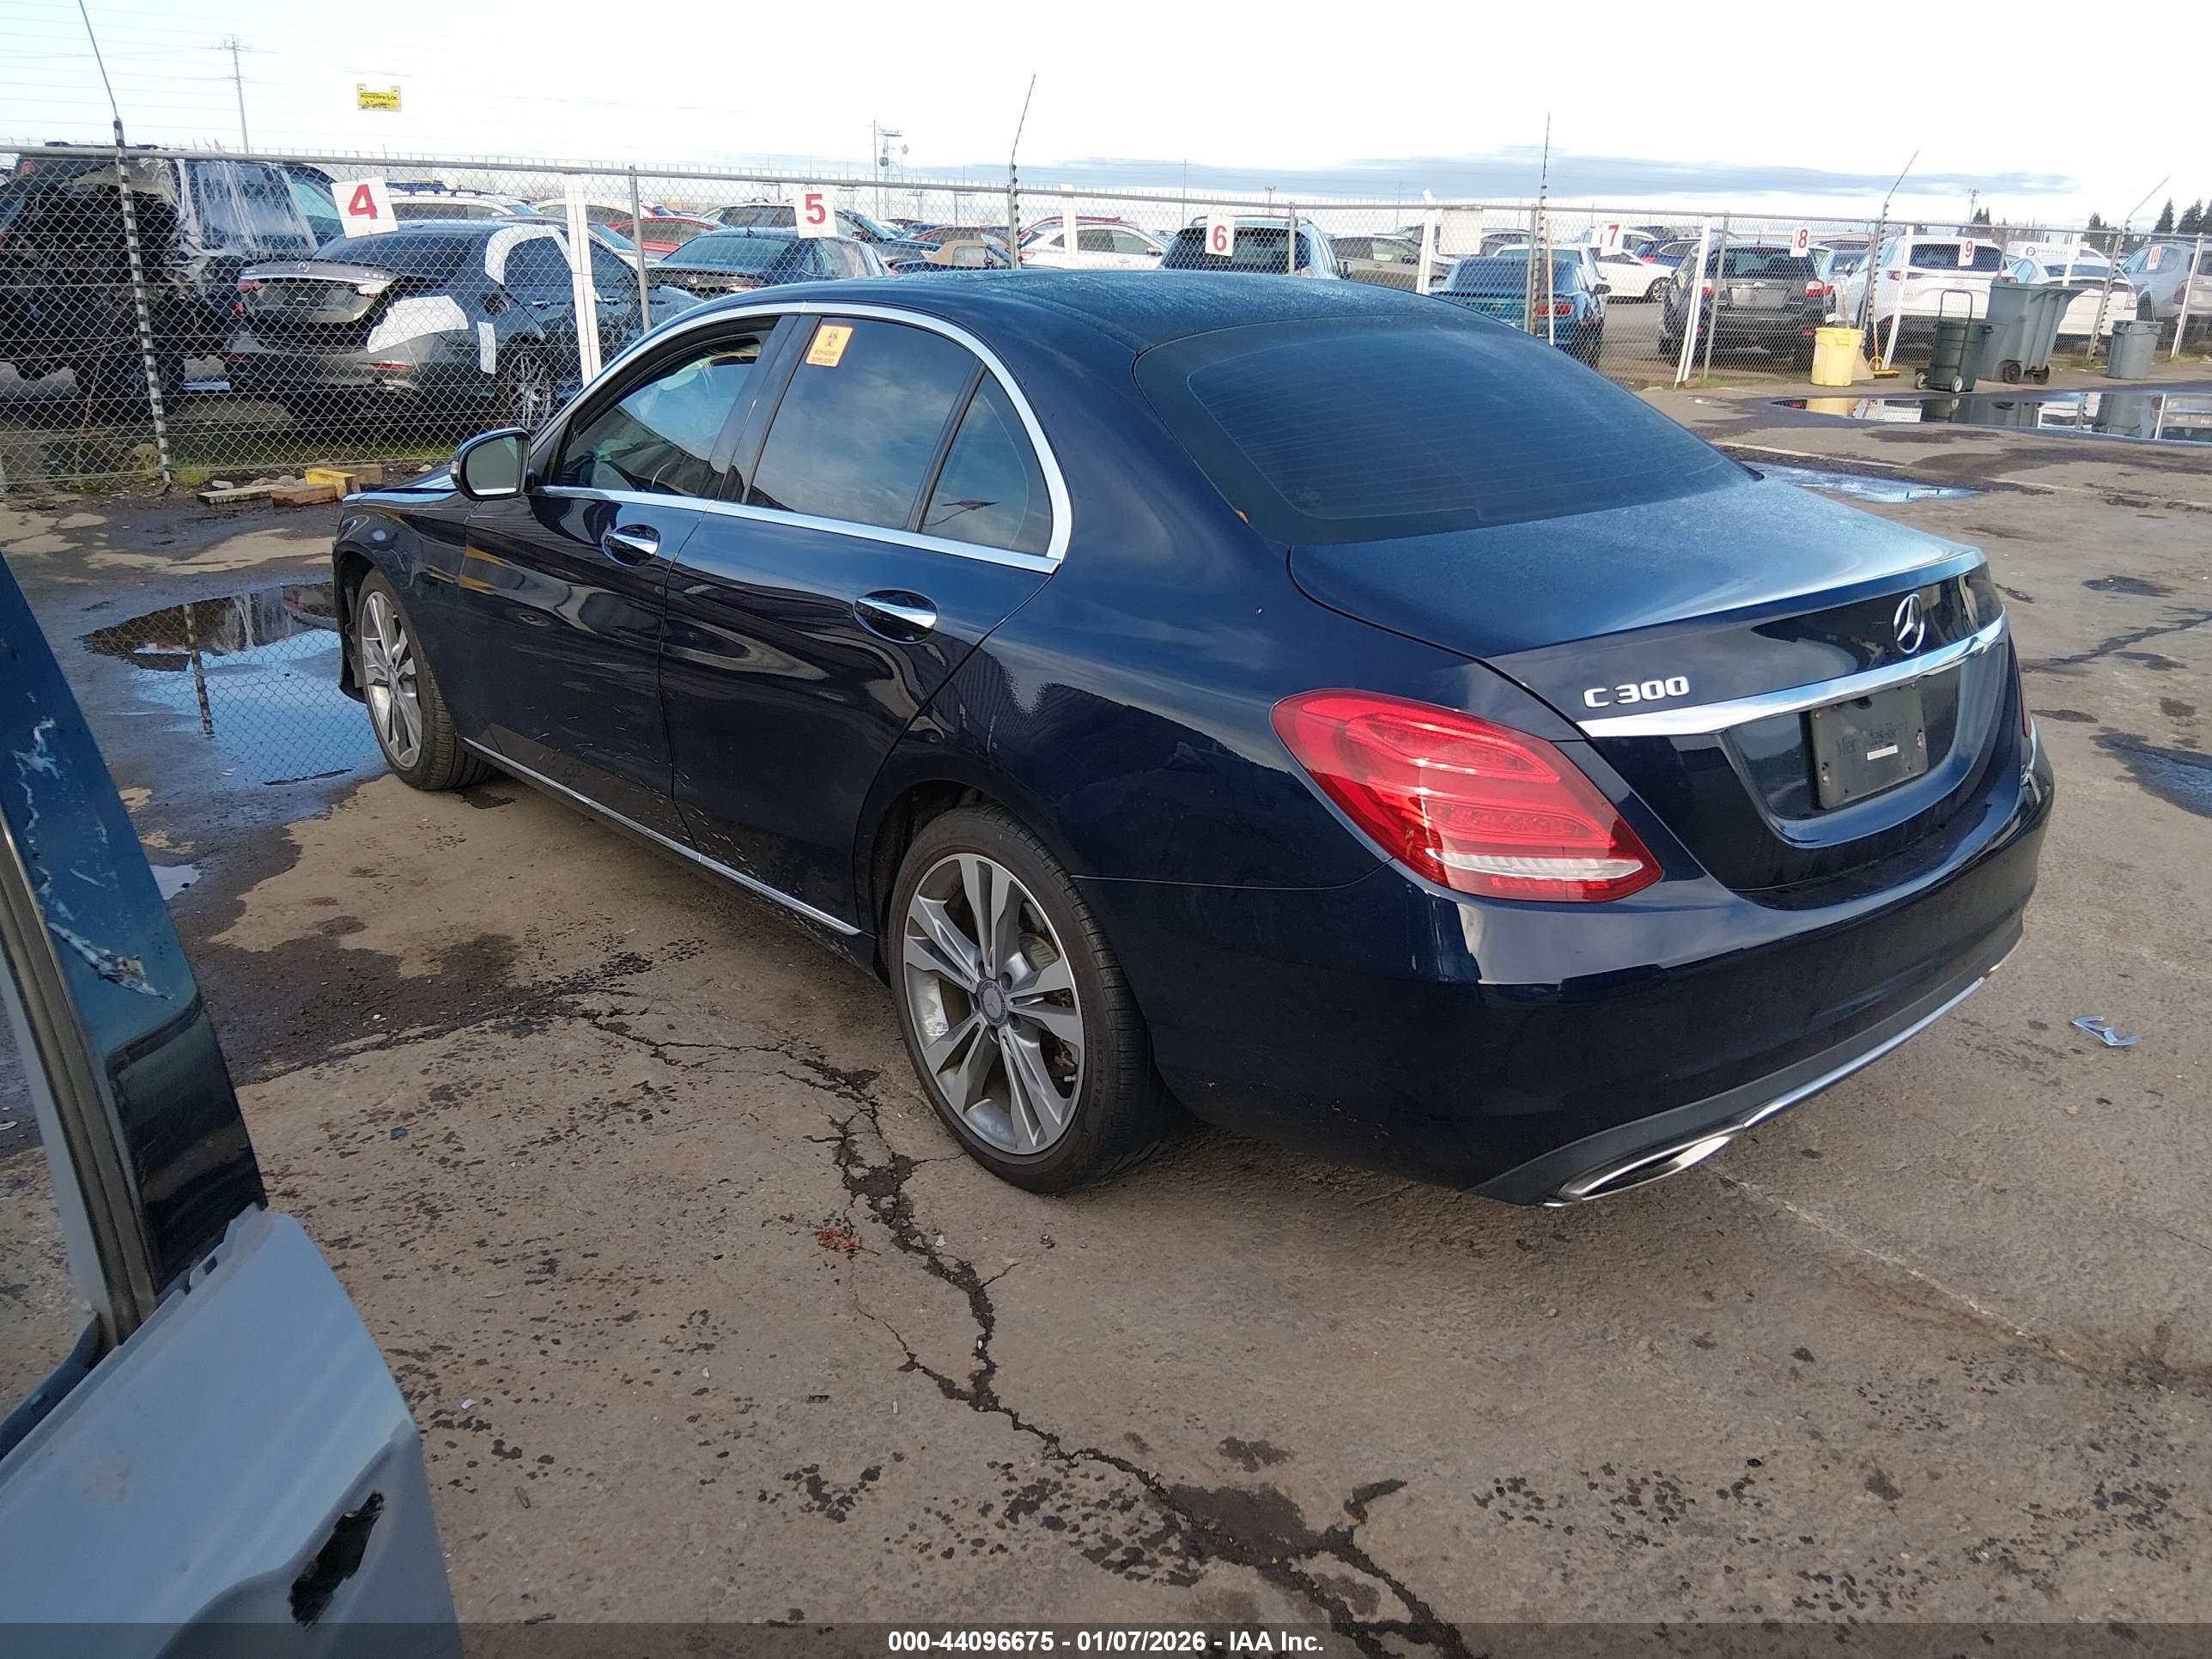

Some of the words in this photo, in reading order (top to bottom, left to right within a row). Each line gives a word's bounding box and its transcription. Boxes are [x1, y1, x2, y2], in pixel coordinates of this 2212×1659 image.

[349, 184, 378, 220] 4
[805, 193, 826, 225] 5
[1212, 225, 1227, 252] 6
[1608, 224, 1620, 246] 7
[1798, 228, 1808, 249] 8
[1965, 240, 1973, 258] 9
[2150, 247, 2160, 264] 10
[1583, 687, 1611, 708] C
[1613, 675, 1690, 704] 300
